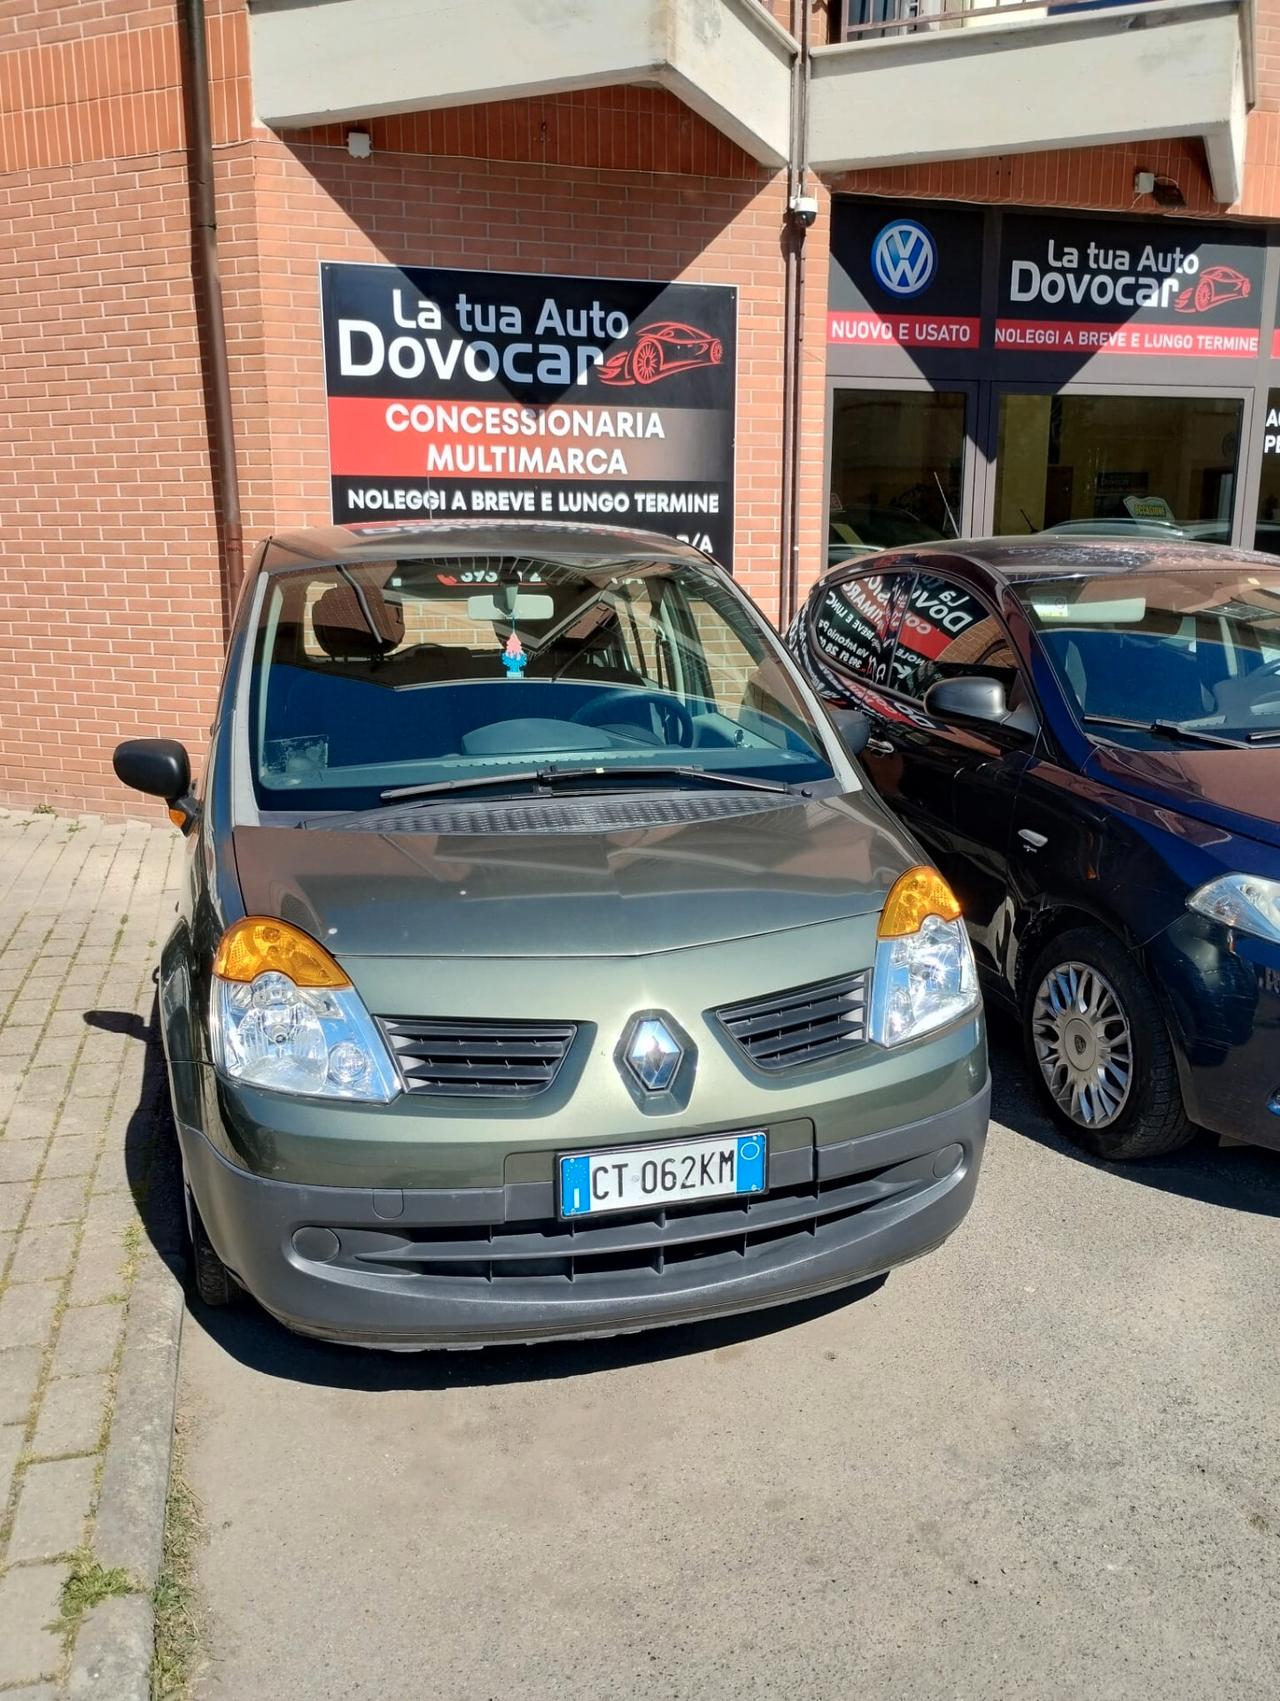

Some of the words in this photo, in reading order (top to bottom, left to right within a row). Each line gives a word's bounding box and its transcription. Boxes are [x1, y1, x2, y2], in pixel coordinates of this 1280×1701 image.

[1047, 240, 1078, 268] La
[1088, 242, 1130, 271] tua
[1137, 245, 1200, 275] Auto
[392, 289, 442, 331] La
[456, 293, 522, 334] tua
[535, 298, 629, 340] Auto
[831, 320, 893, 340] NUOVO
[899, 323, 909, 340] E
[915, 323, 971, 342] USATO
[994, 327, 1059, 345] NOLEGGI
[1063, 329, 1075, 345] A
[1078, 330, 1126, 347] BREVE
[1131, 332, 1140, 347] E
[1144, 333, 1193, 349] LUNGO
[1196, 335, 1259, 352] TERMINE
[385, 403, 665, 439] CONCESSIONARIA
[427, 443, 628, 475] MULTIMARCA
[348, 489, 446, 510] NOLEGGI
[451, 490, 467, 511] A
[471, 491, 535, 512] BREVE
[541, 491, 553, 512] E
[558, 492, 630, 513] LUNGO
[634, 493, 719, 514] TERMINE
[592, 1163, 629, 1200] CT
[640, 1149, 736, 1194] 062KM
